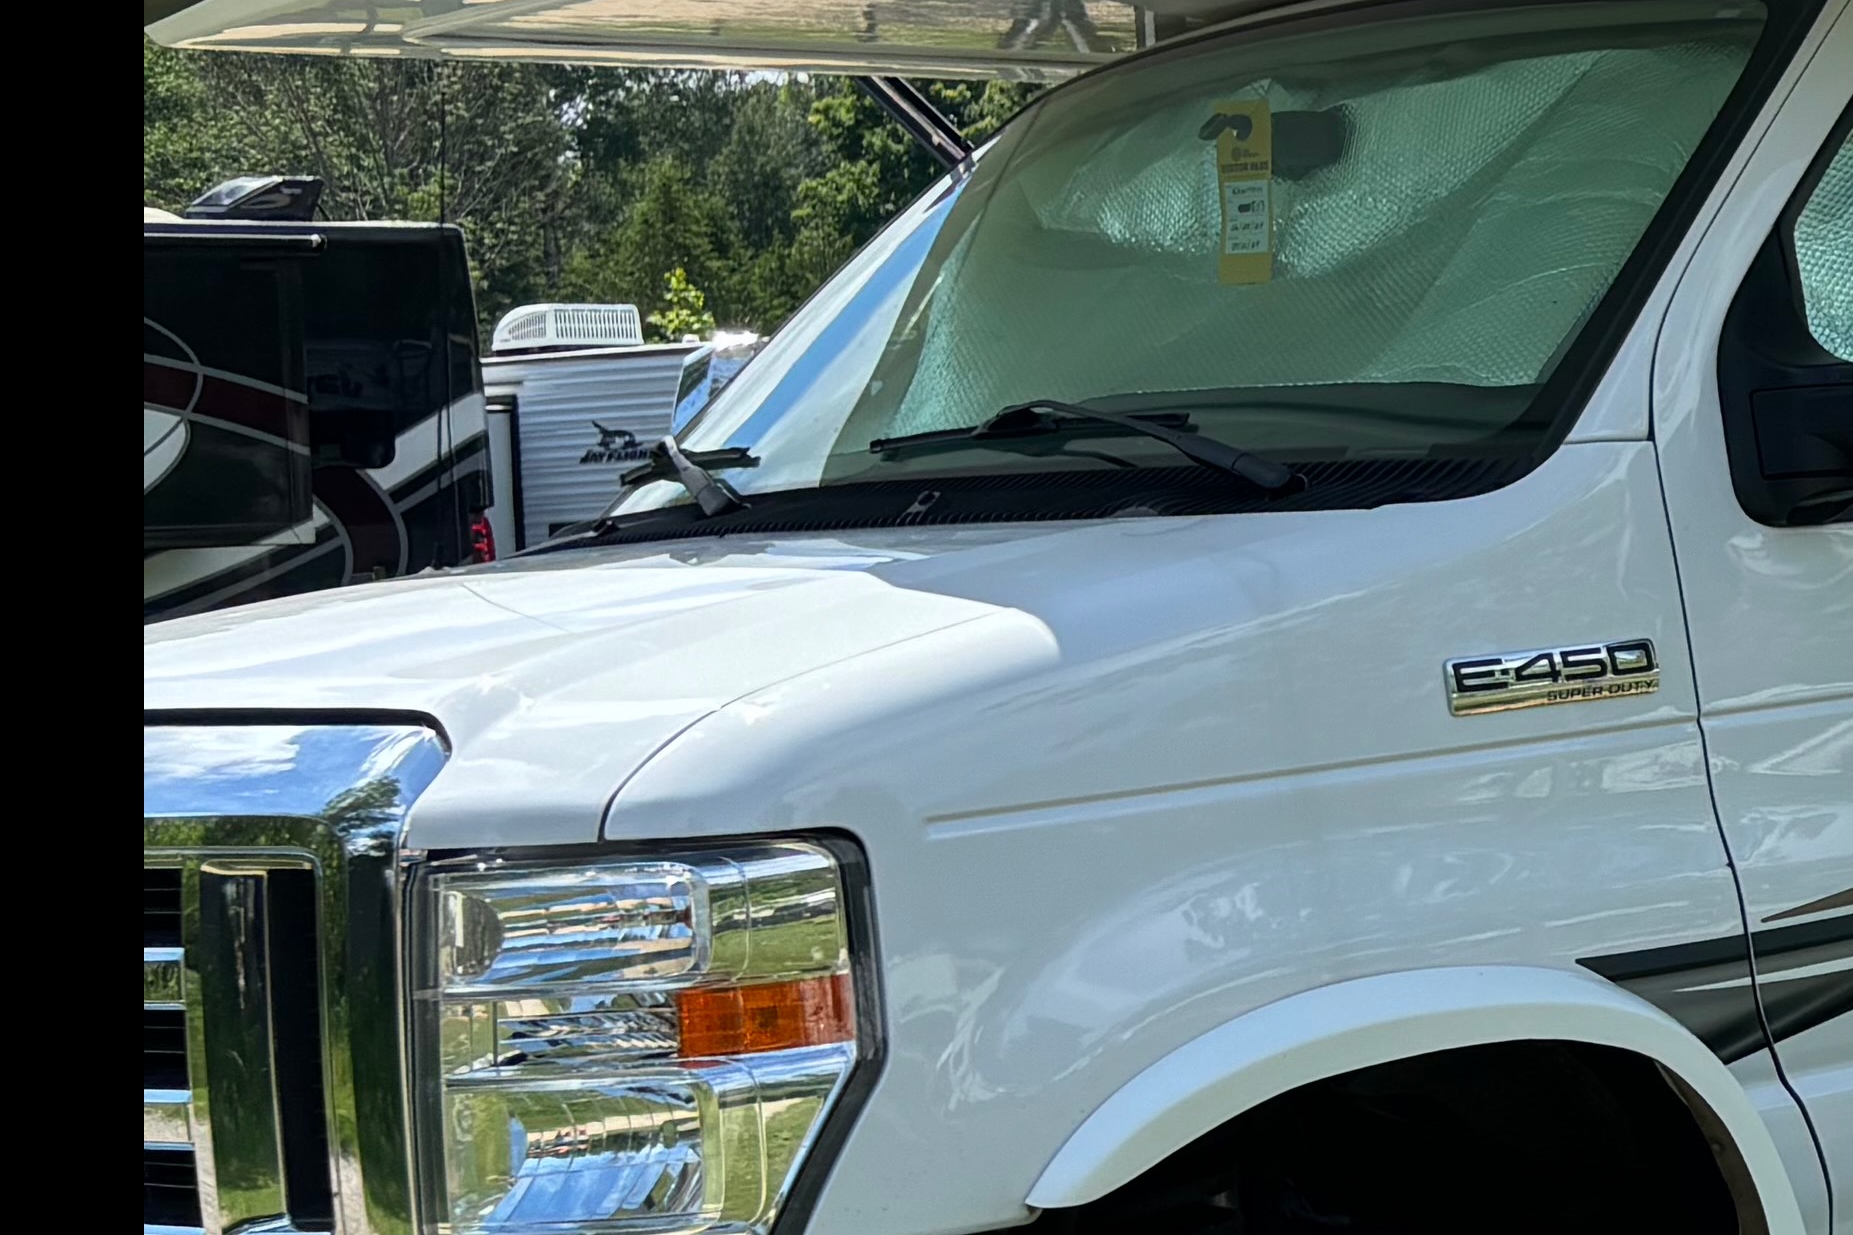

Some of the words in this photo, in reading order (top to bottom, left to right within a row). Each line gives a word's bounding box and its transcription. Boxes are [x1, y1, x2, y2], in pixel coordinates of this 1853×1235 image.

[1452, 642, 1656, 693] E-450
[1547, 686, 1604, 701] SUPER
[1608, 679, 1656, 694] DUTY
